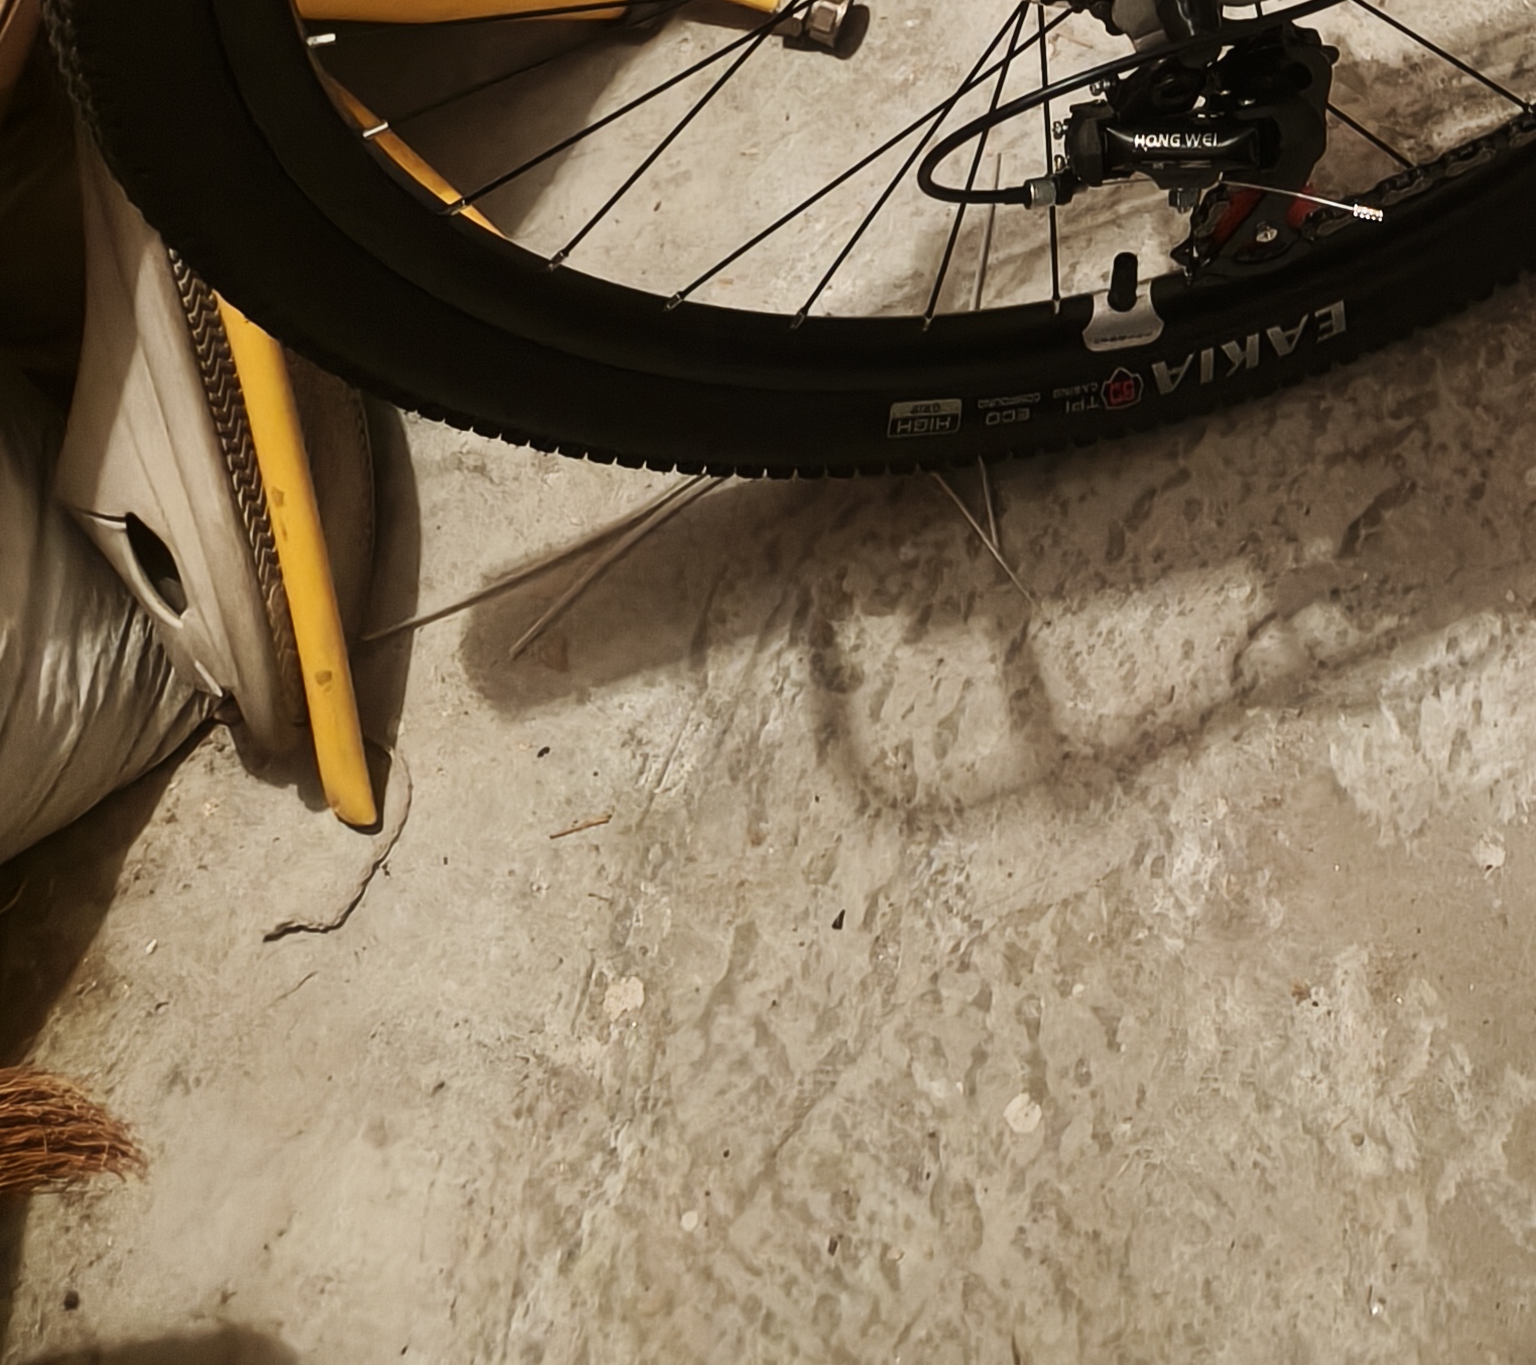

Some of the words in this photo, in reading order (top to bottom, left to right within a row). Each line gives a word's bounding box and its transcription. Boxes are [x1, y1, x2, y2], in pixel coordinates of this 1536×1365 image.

[1134, 131, 1182, 153] HONG
[1185, 131, 1219, 149] WEI
[1152, 300, 1348, 396] EAKIA
[895, 416, 953, 435] HIGH
